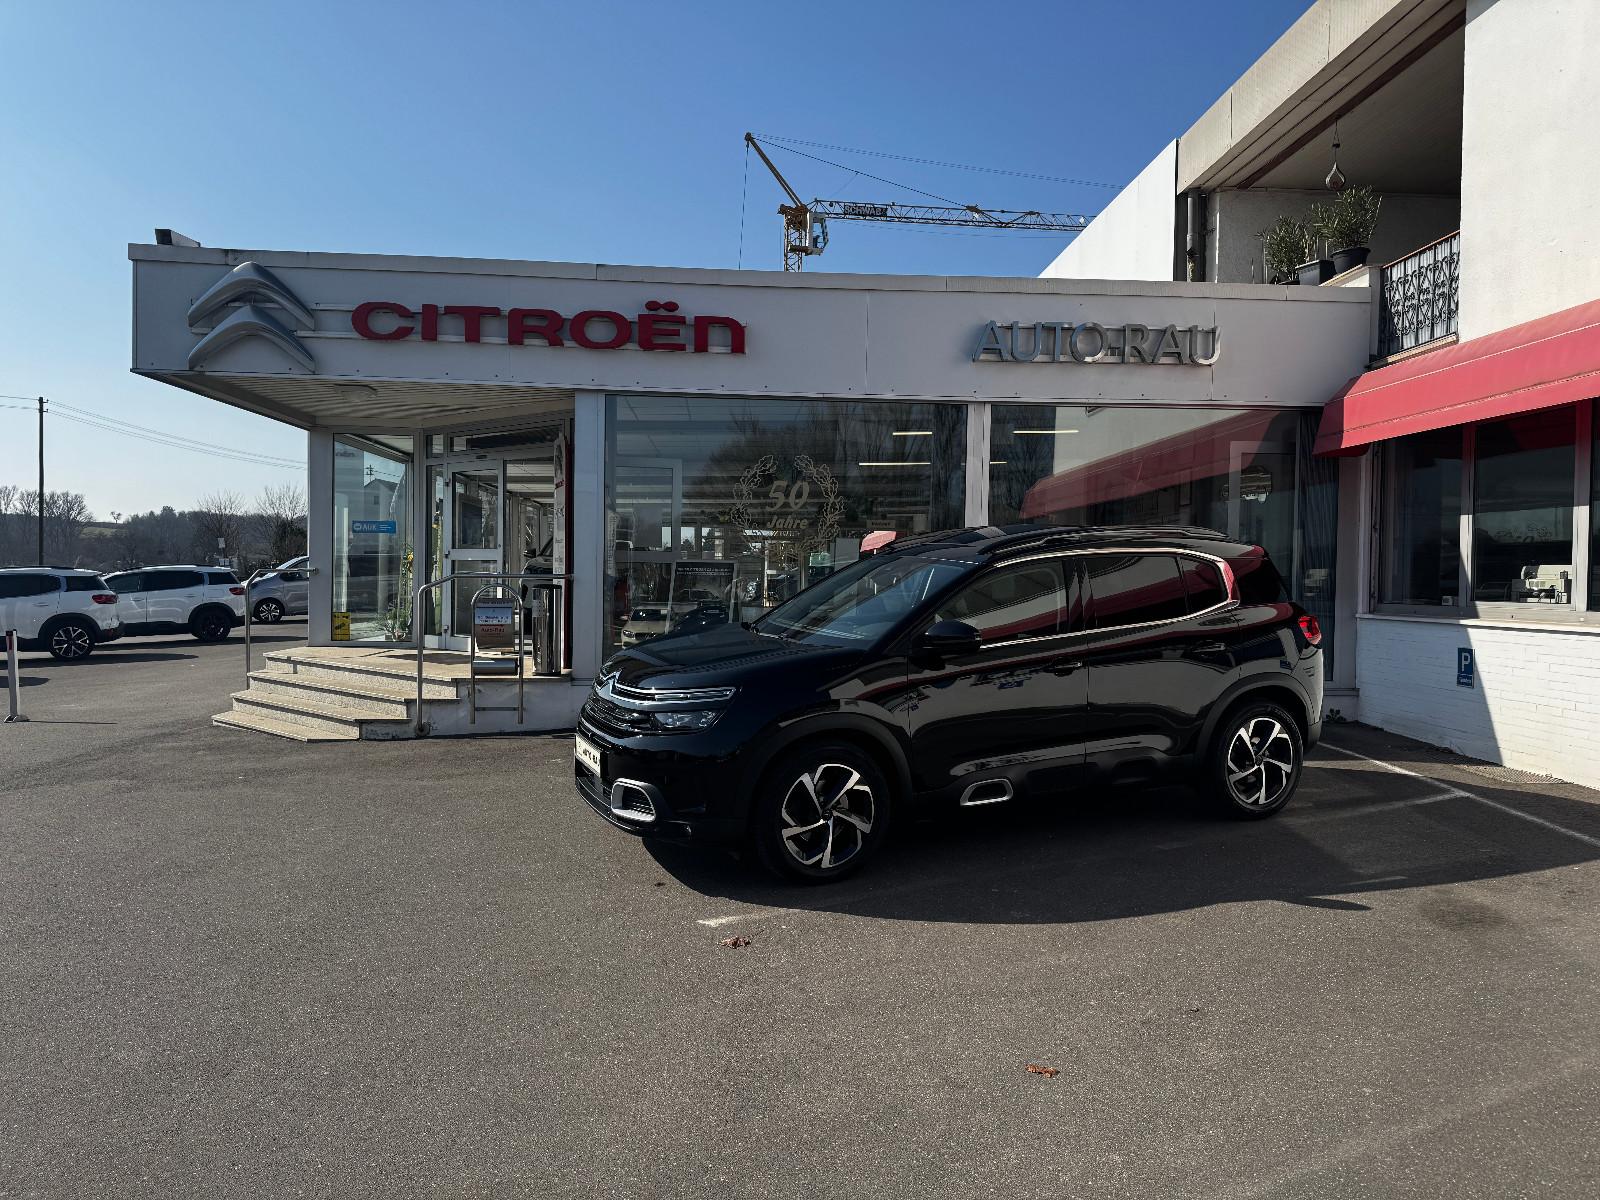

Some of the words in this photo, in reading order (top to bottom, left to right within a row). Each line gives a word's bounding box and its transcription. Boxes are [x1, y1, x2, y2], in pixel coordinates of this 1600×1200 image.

[765, 480, 810, 511] 50
[767, 515, 809, 529] Jahre
[1461, 652, 1471, 672] P
